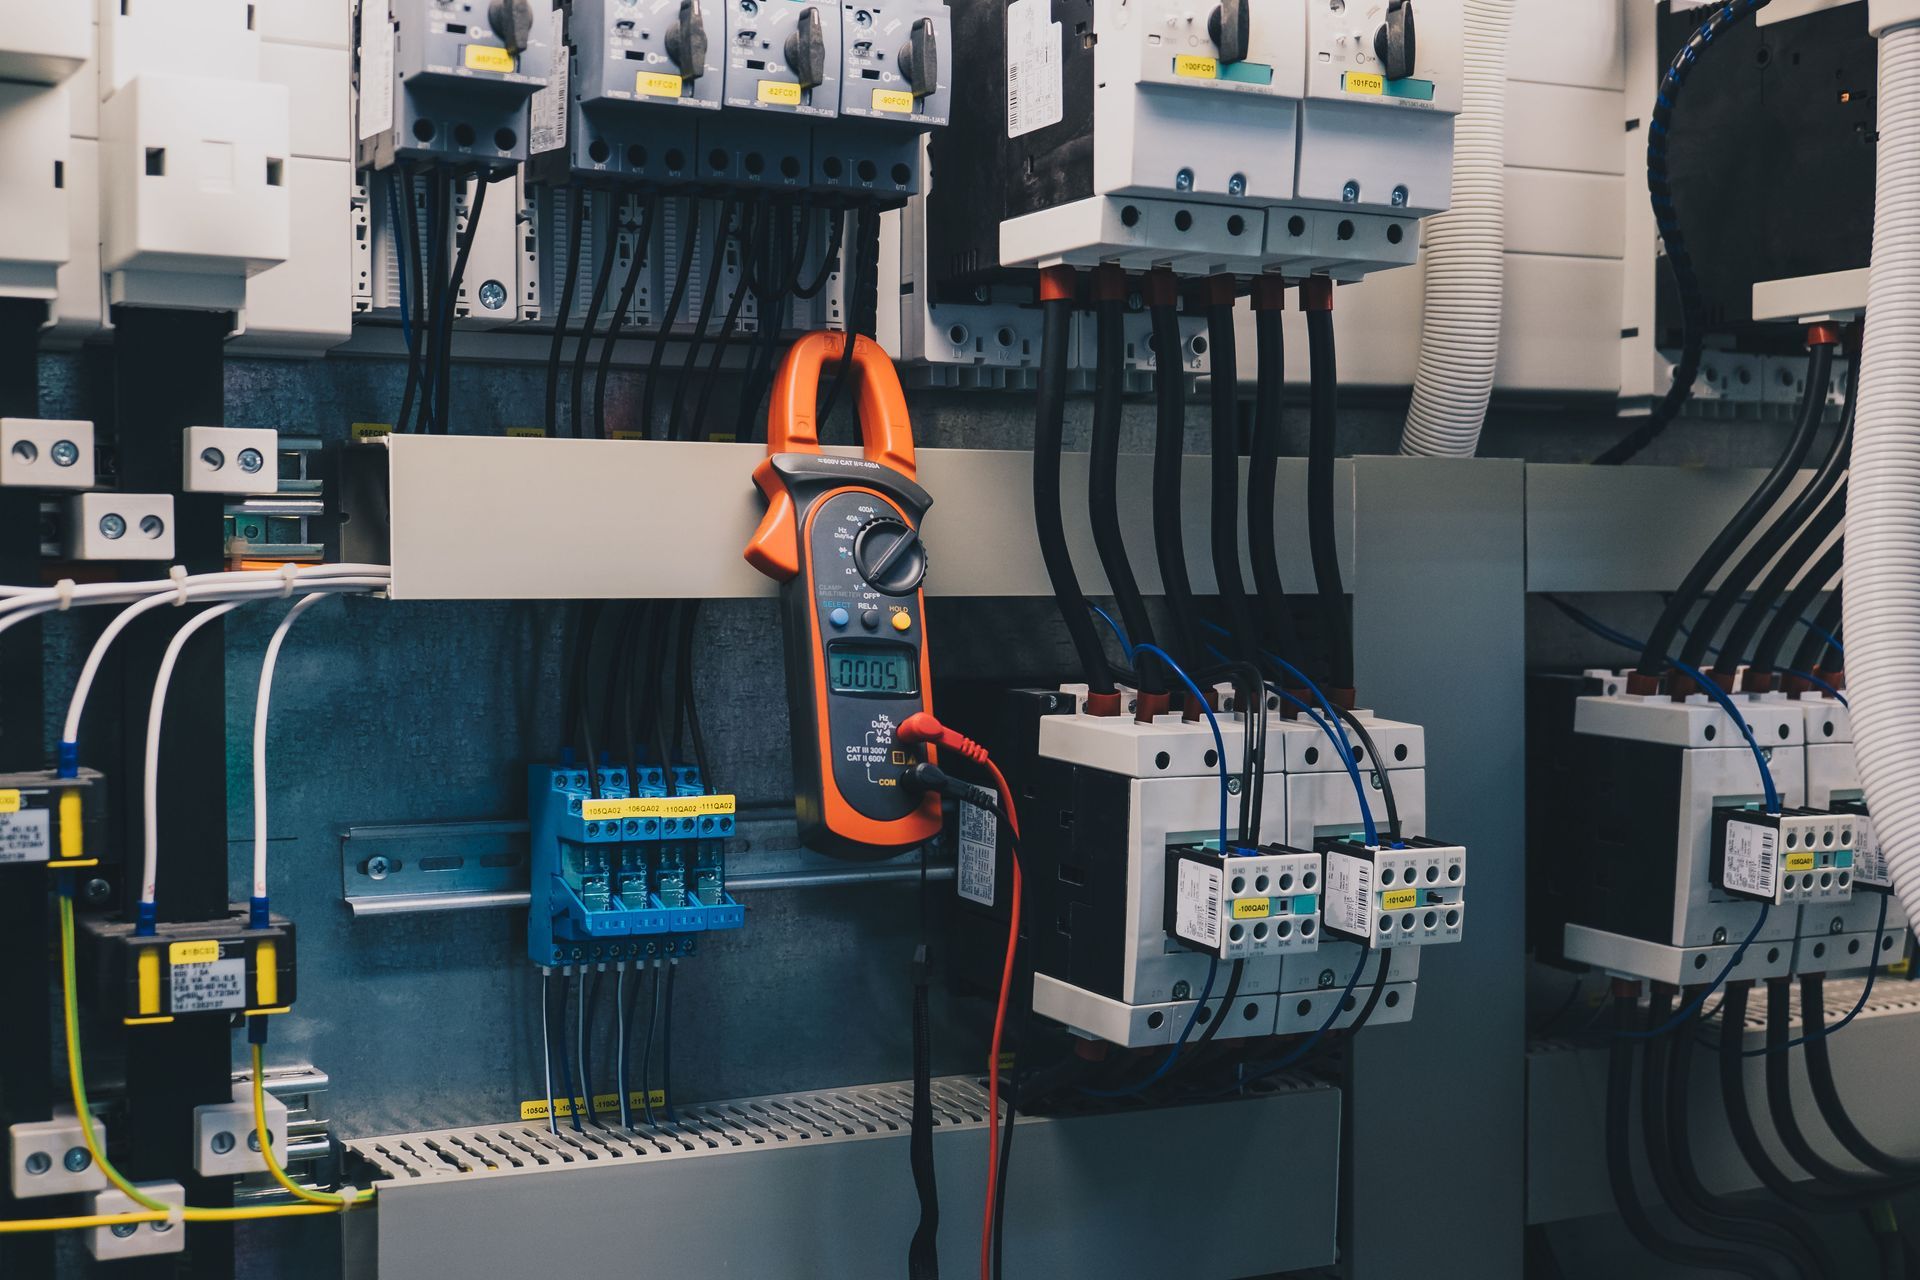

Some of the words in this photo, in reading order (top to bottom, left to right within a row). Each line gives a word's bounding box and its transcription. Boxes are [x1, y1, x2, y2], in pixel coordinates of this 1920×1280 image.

[1182, 62, 1215, 73] -100FC01
[1351, 79, 1381, 90] -101FC01
[818, 590, 861, 598] MULTIMETER
[1386, 895, 1415, 904] -101QA01
[1238, 904, 1268, 913] -100QA01
[524, 1106, 556, 1115] -105QA2
